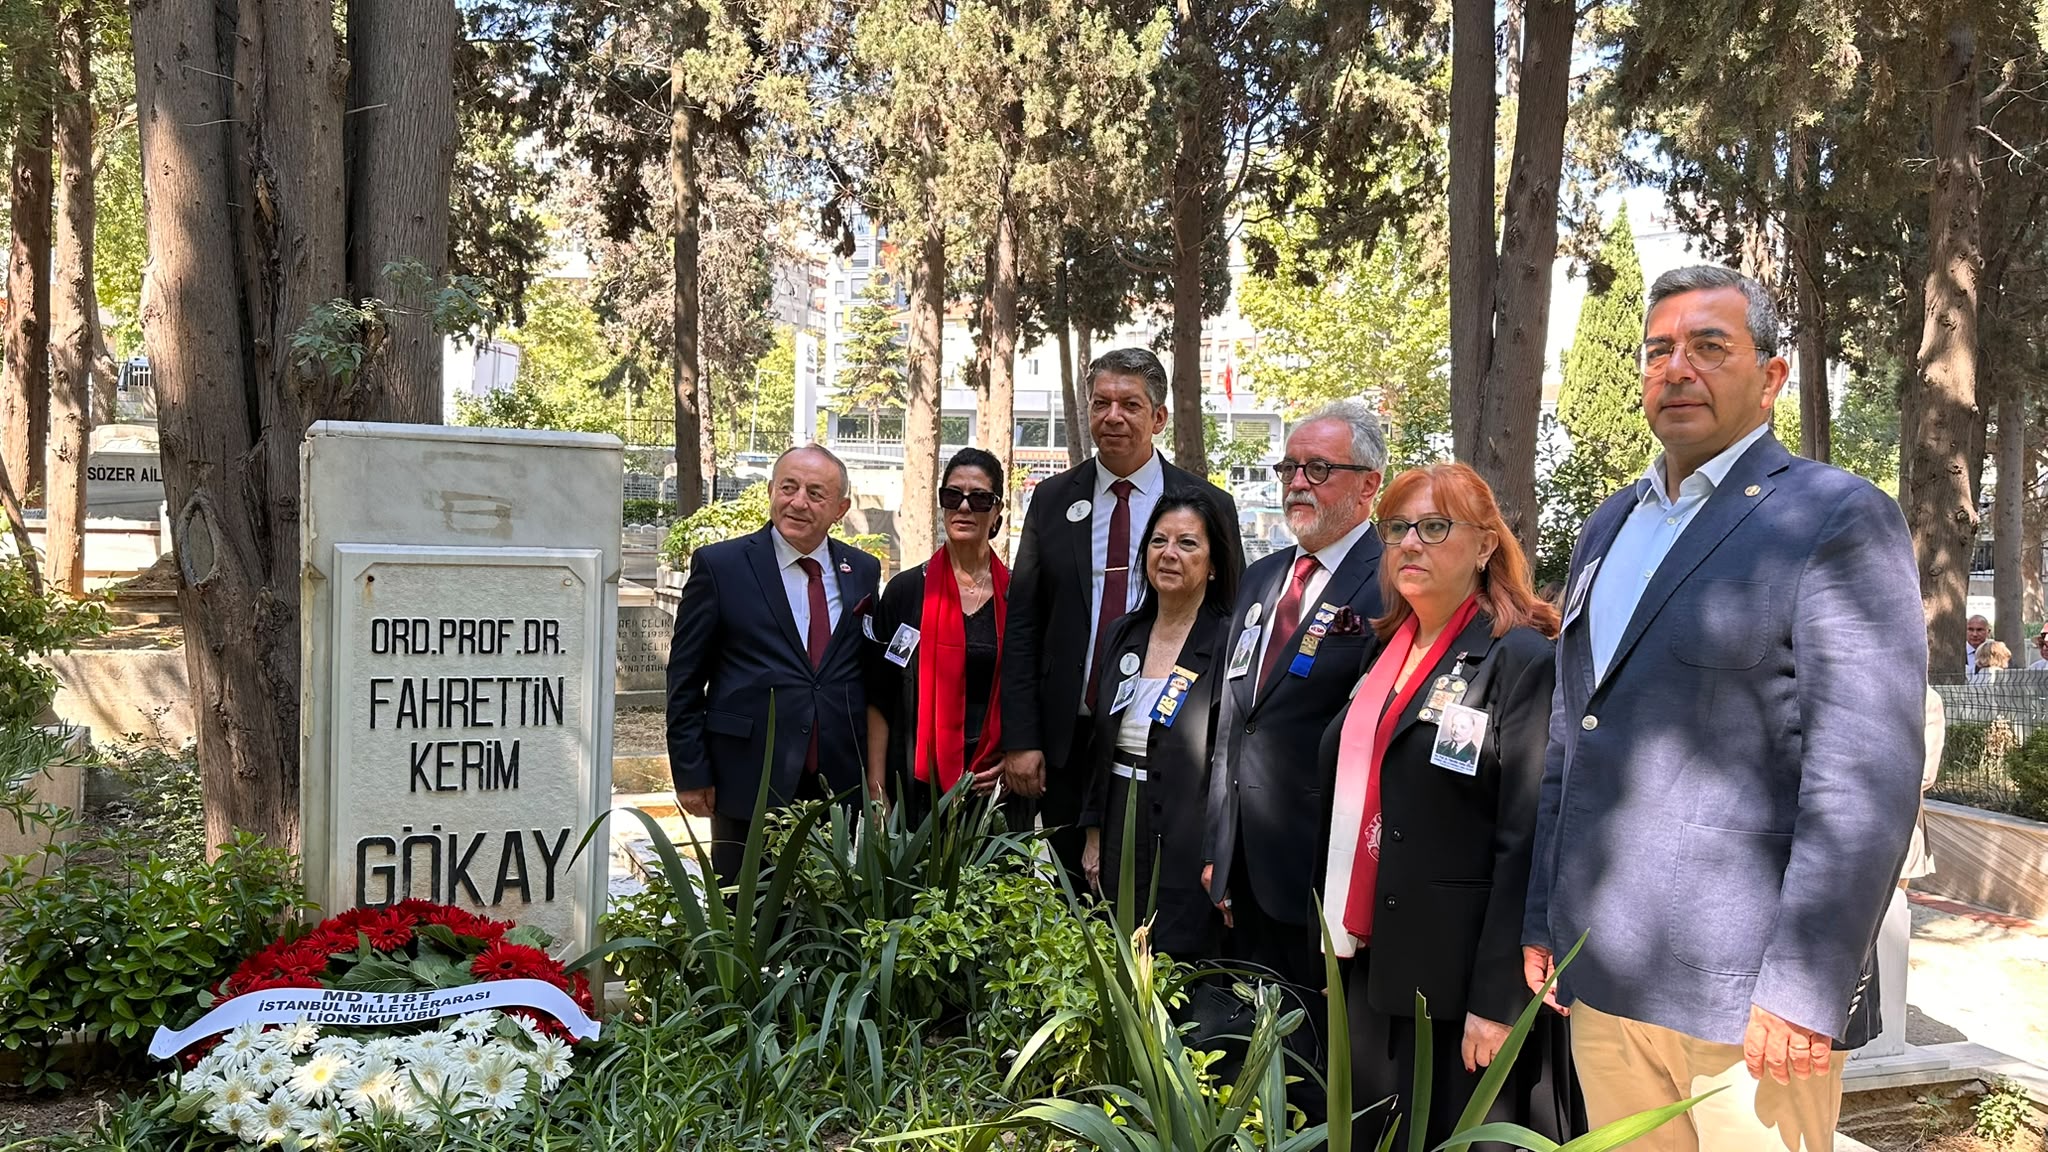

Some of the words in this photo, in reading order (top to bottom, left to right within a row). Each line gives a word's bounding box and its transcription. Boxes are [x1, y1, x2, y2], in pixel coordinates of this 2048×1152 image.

[87, 464, 136, 482] SÖZER
[141, 466, 163, 482] AİL
[618, 619, 637, 628] AFA
[369, 676, 565, 730] FAHRETTİN
[410, 738, 521, 793] KERİM
[356, 824, 572, 909] GÖKAY
[258, 1000, 343, 1012] İSTANBUL
[349, 991, 491, 1013] MİLLETLERARASI
[323, 990, 363, 1002] MD
[373, 991, 435, 1003] 118T
[307, 1011, 361, 1024] LİONS
[367, 1008, 441, 1024] KULÜBÜ
